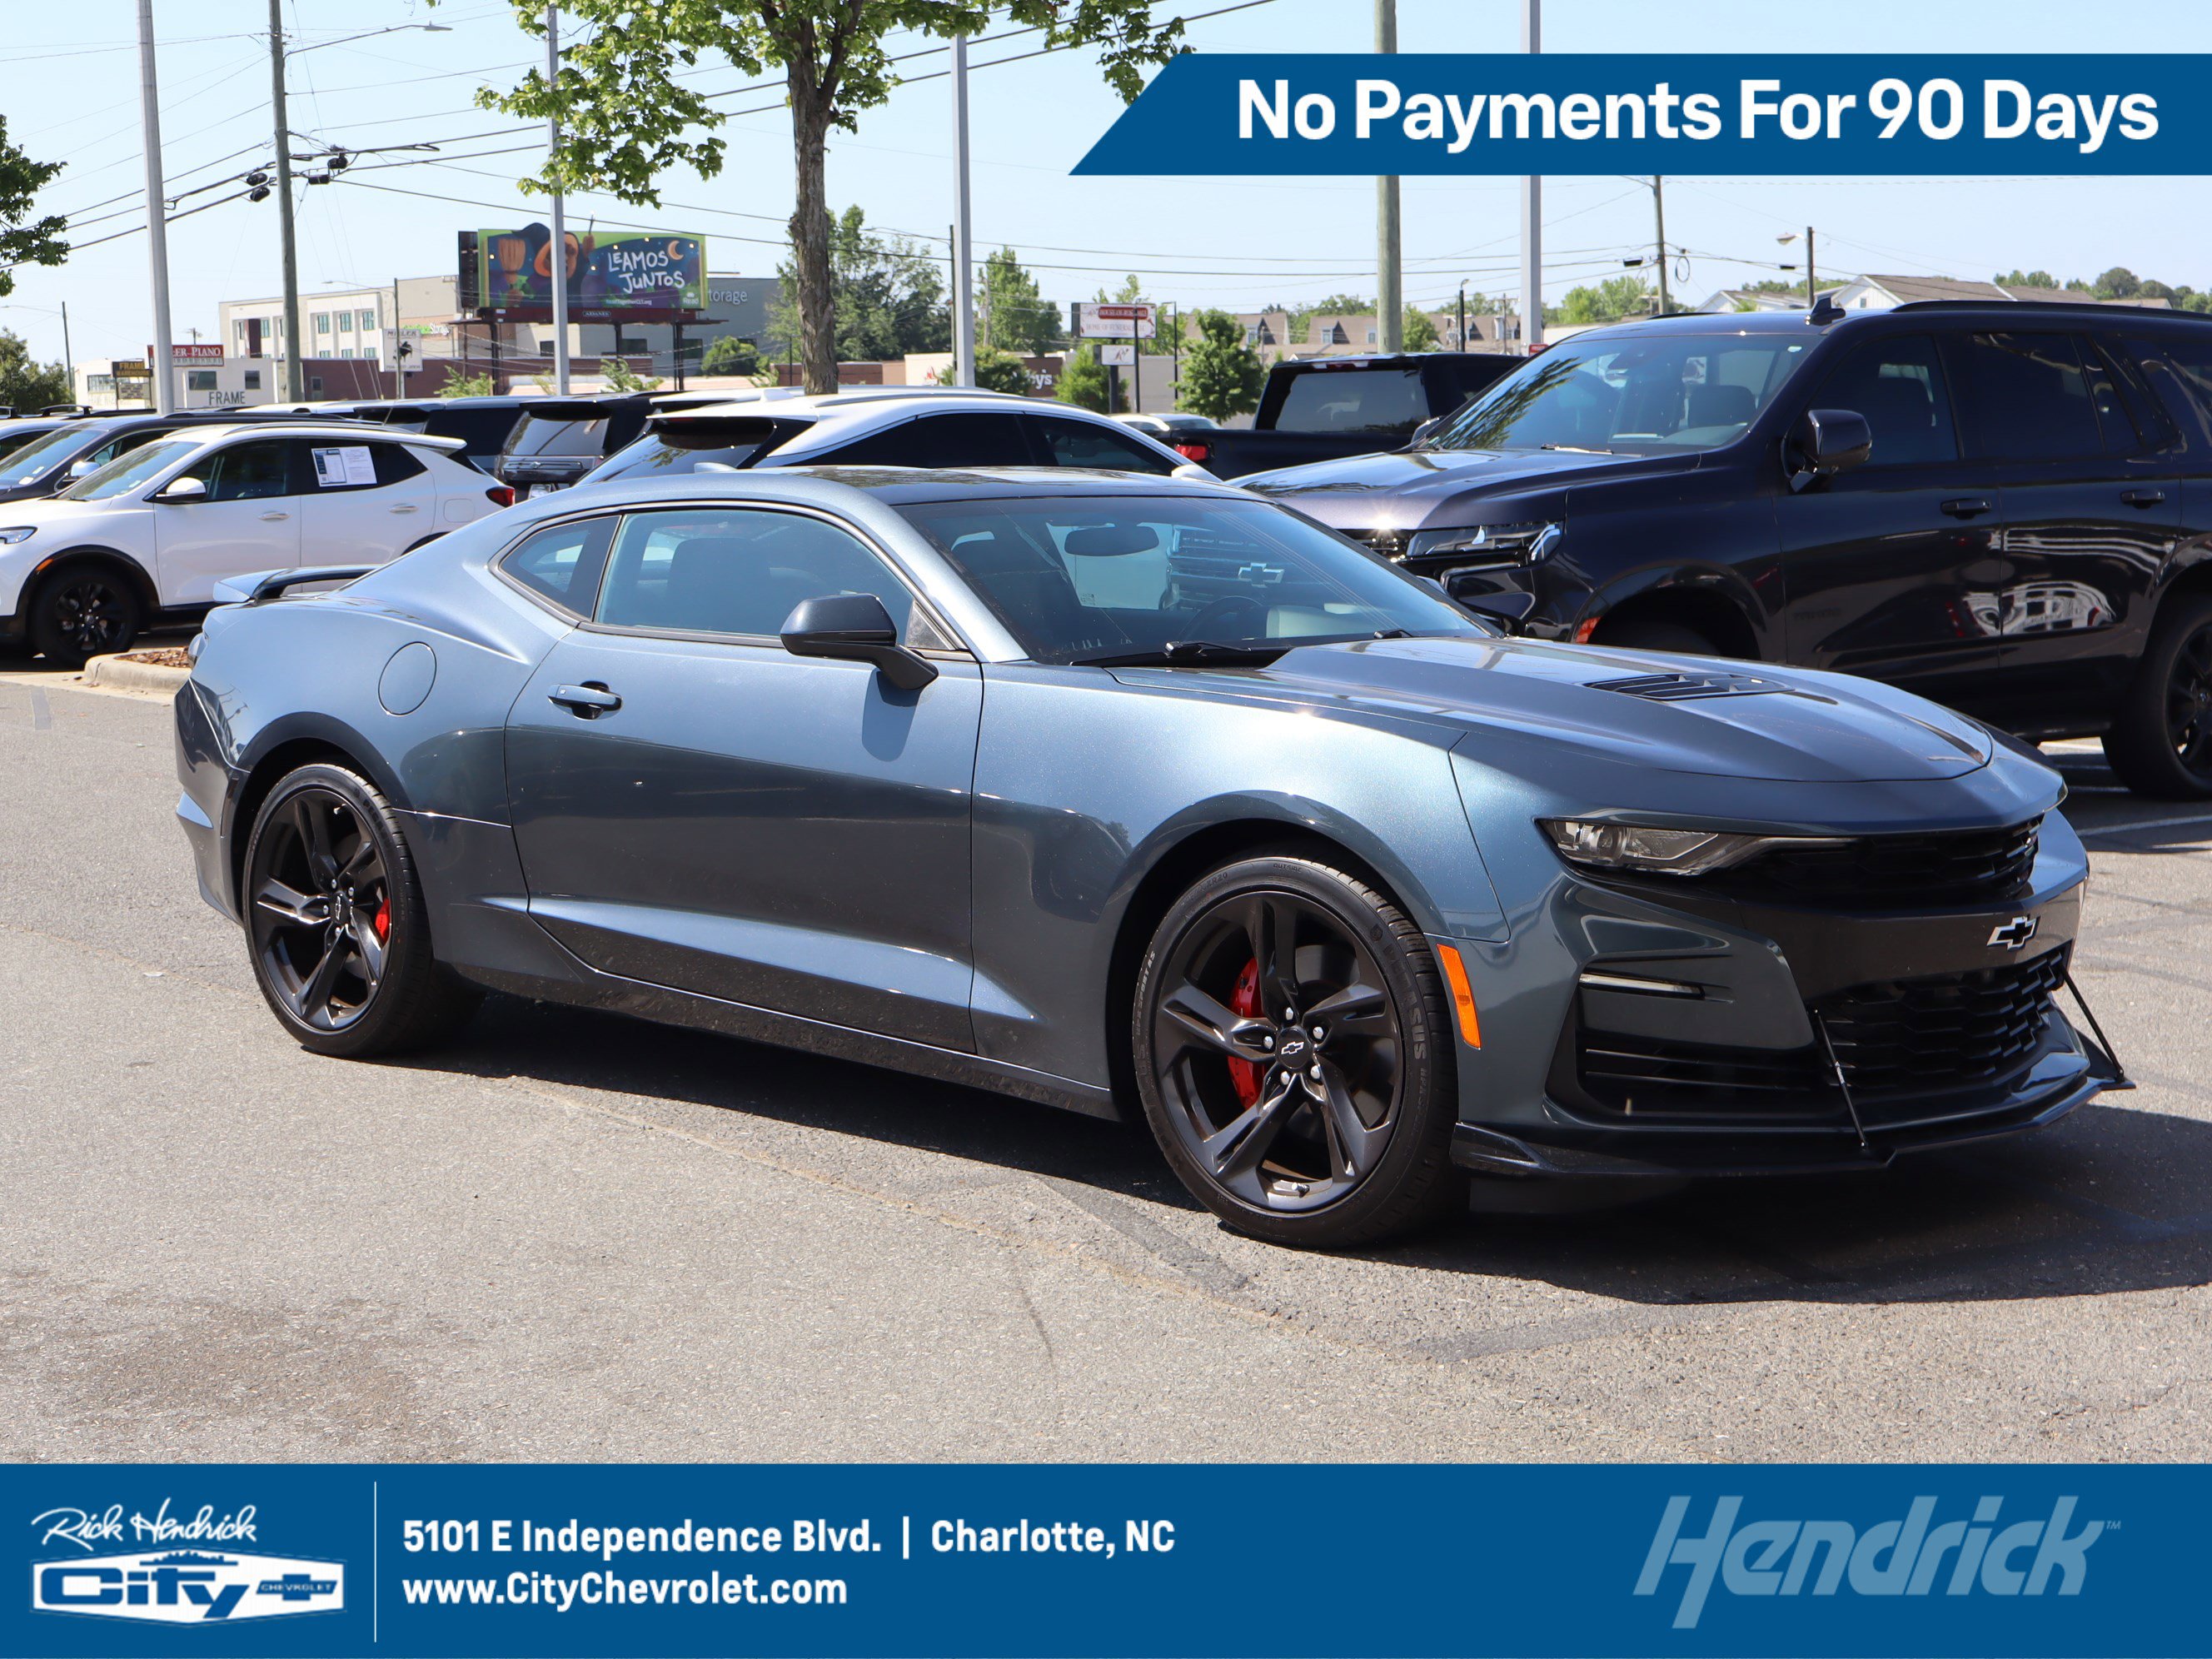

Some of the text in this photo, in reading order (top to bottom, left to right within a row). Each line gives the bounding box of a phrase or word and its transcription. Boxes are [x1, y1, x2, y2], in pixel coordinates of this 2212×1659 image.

[608, 251, 669, 272] LEAMOS
[619, 271, 685, 294] JUNTOS
[709, 289, 748, 305] torage
[209, 391, 246, 406] FRAME
